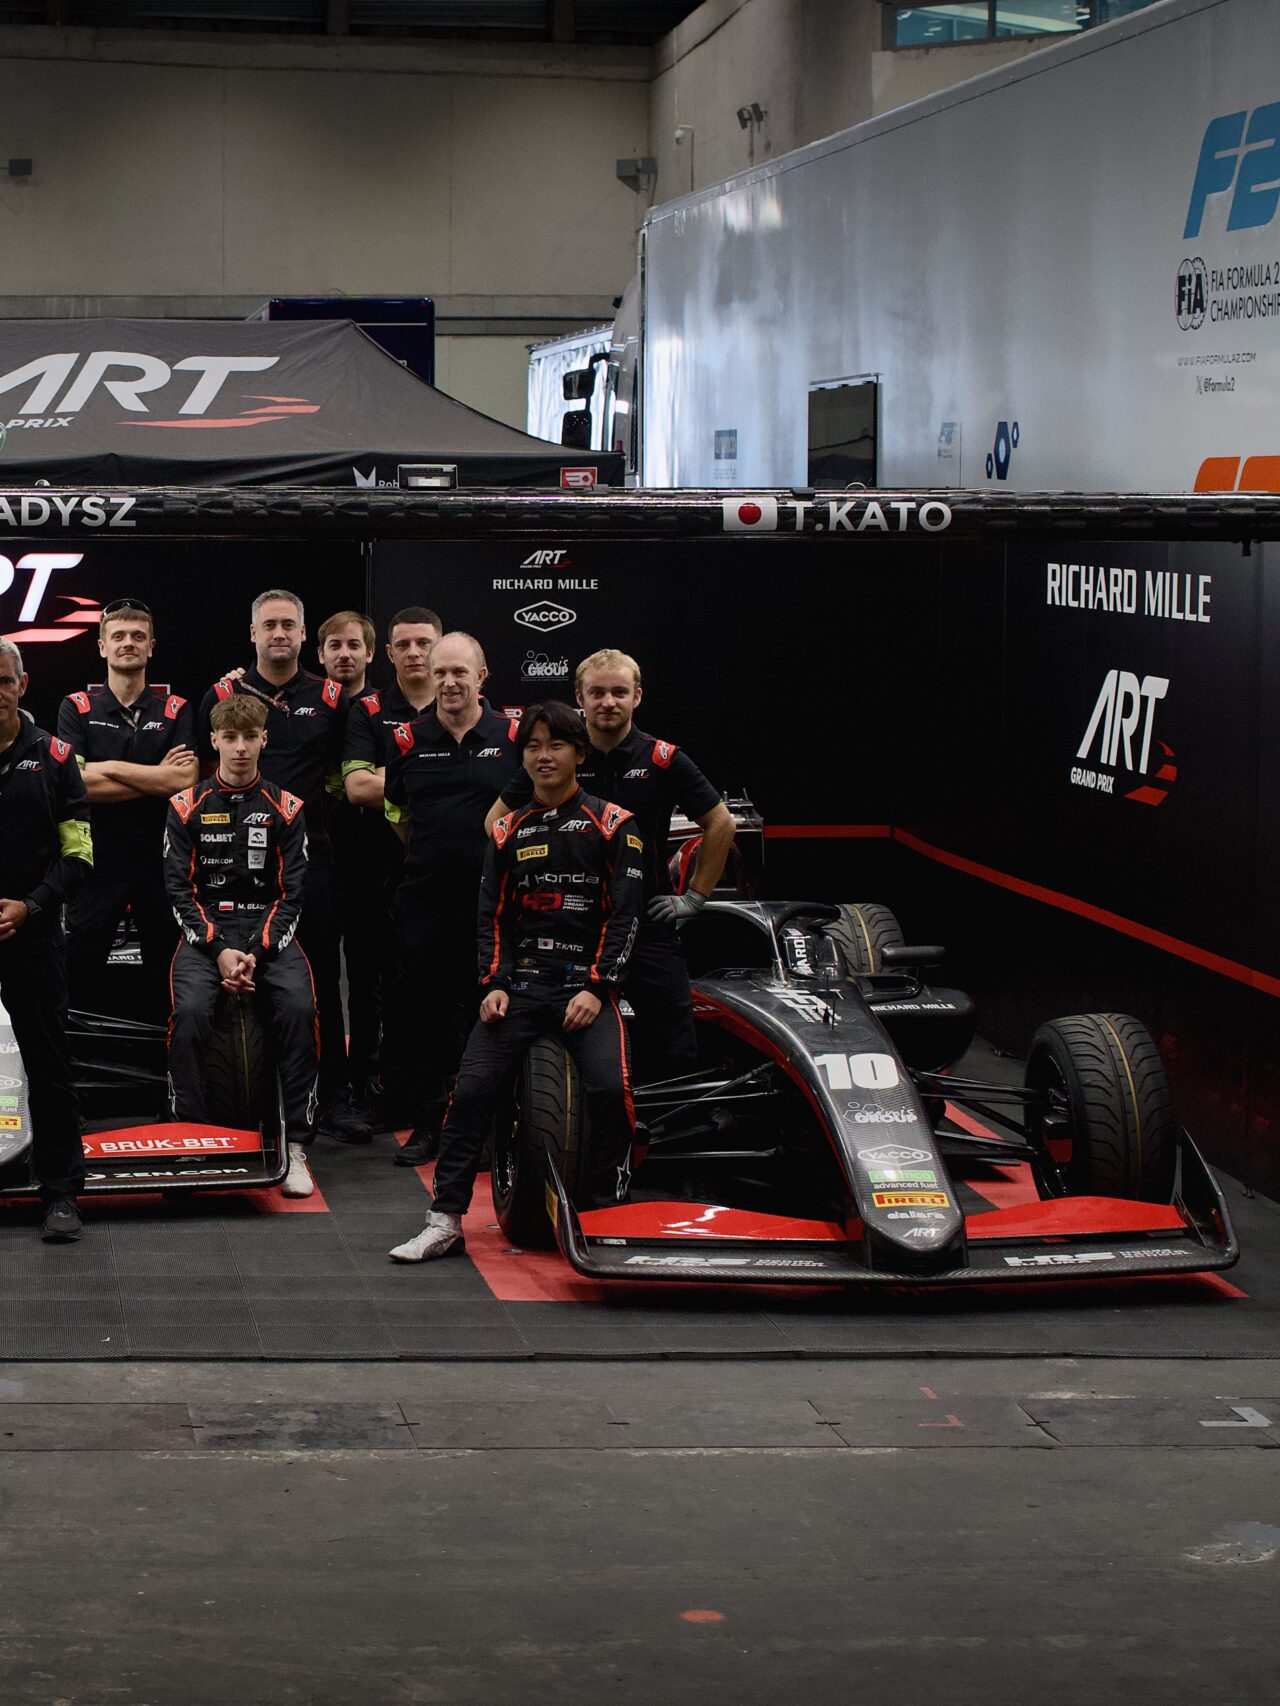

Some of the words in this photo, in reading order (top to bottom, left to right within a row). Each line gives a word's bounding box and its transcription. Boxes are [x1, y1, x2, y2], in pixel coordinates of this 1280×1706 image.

[1211, 269, 1224, 292] FIA
[1227, 264, 1270, 290] FORMULA
[5, 417, 75, 429] PRIX
[786, 501, 952, 532] T.KATO
[522, 550, 568, 564] ART
[493, 579, 553, 590] RICHARD
[558, 579, 598, 590] MILLE
[1046, 563, 1137, 615] RICHARD
[1144, 570, 1212, 623] MILLE
[522, 611, 570, 622] YACCO
[528, 666, 569, 677] GROUP
[1076, 669, 1170, 775] ART
[477, 748, 500, 757] ART
[15, 760, 39, 769] ART
[623, 768, 648, 777] ART
[1070, 766, 1096, 790] GRAND
[1096, 772, 1115, 794] PRIX
[243, 813, 271, 823] ART
[559, 819, 592, 831] ART
[555, 942, 584, 952] T.KATO
[814, 1053, 900, 1090] 10
[855, 1111, 918, 1123] GROUP
[100, 1137, 234, 1151] BRUK-BET
[867, 1151, 925, 1160] YACCO
[114, 1168, 249, 1178] ZEN.COM
[875, 1193, 946, 1205] PIRELLI
[887, 1210, 946, 1219] dallara
[903, 1227, 941, 1238] ART
